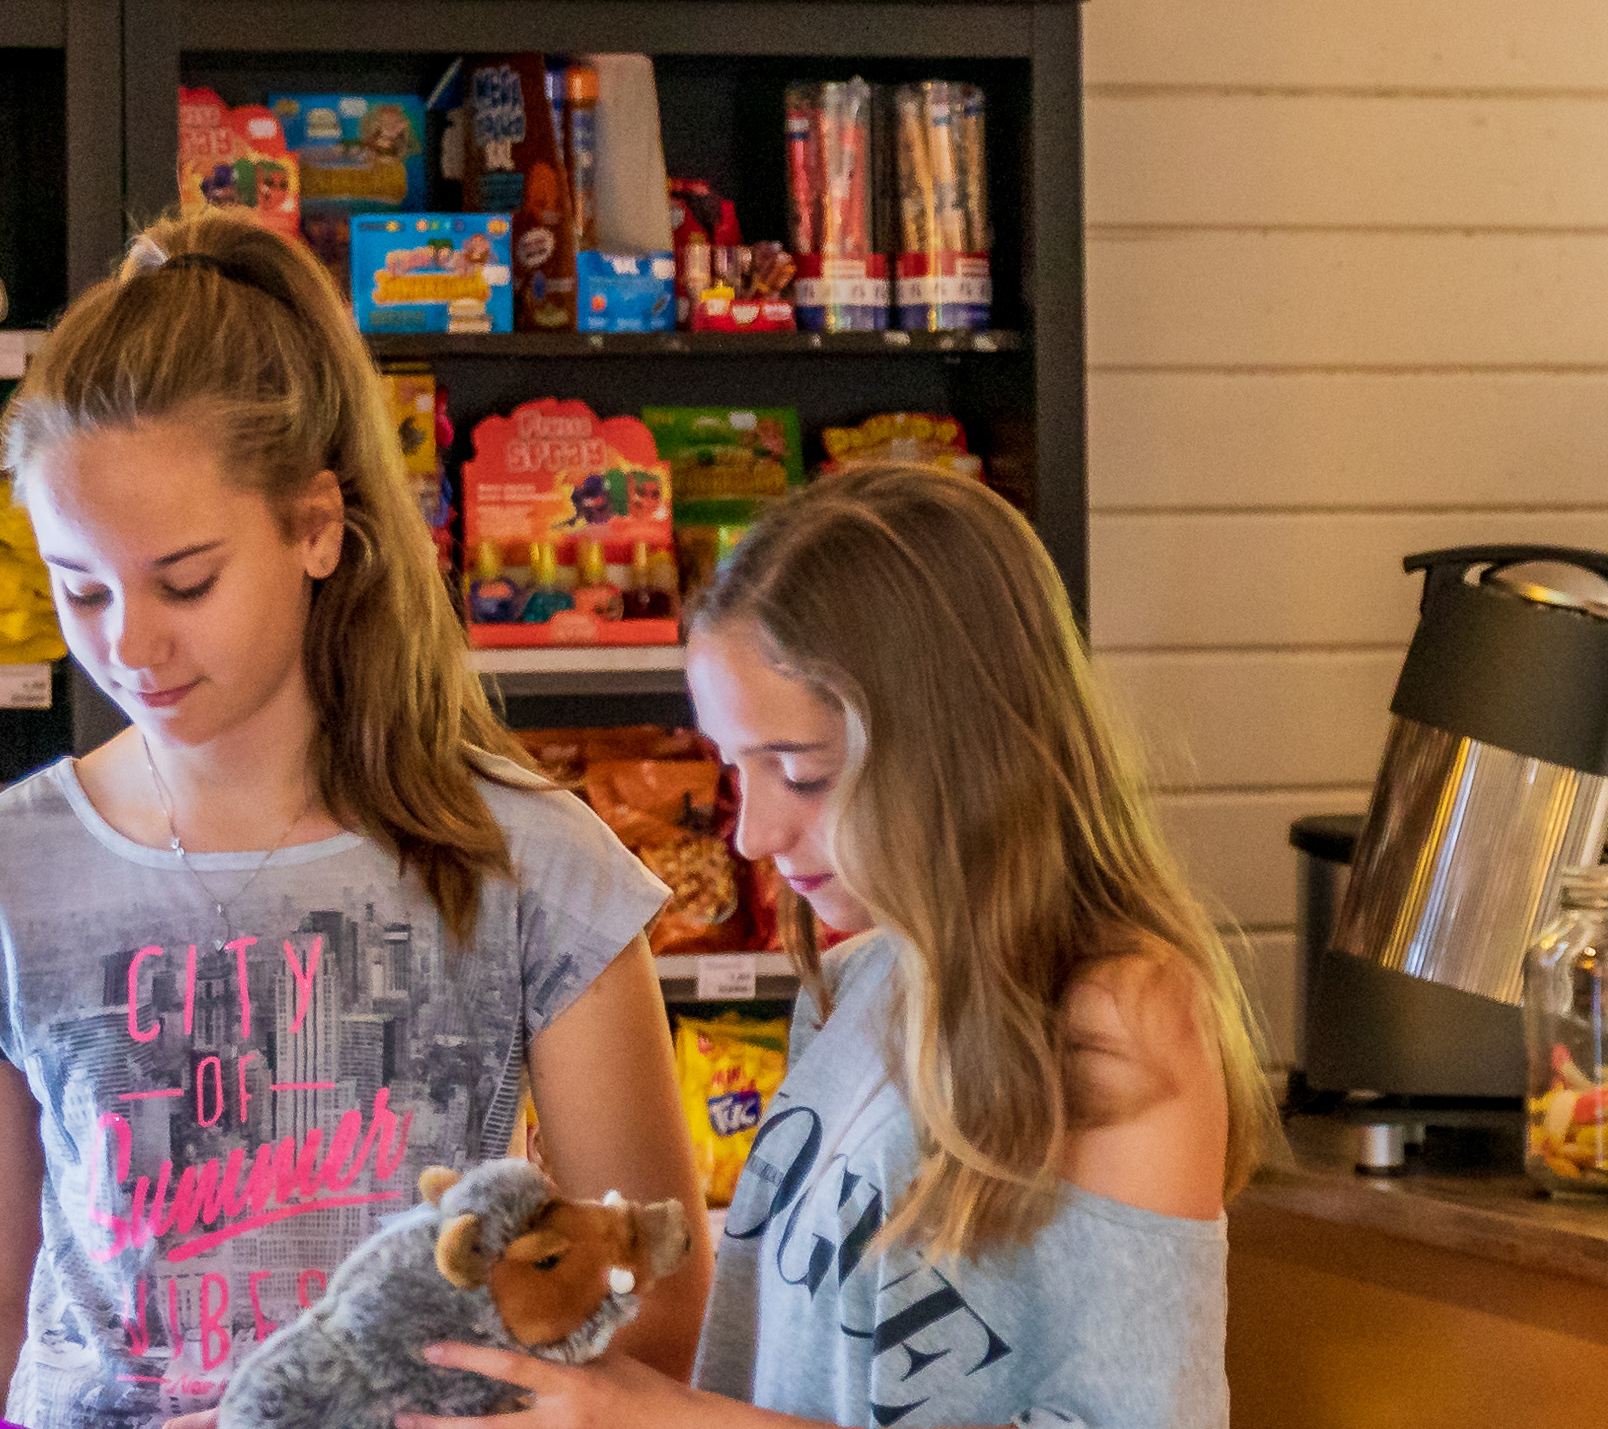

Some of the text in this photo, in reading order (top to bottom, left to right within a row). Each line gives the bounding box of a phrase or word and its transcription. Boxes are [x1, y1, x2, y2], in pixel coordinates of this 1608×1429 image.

[127, 936, 323, 1043] CITY
[196, 1055, 257, 1128] OF
[89, 1087, 414, 1263] Summer
